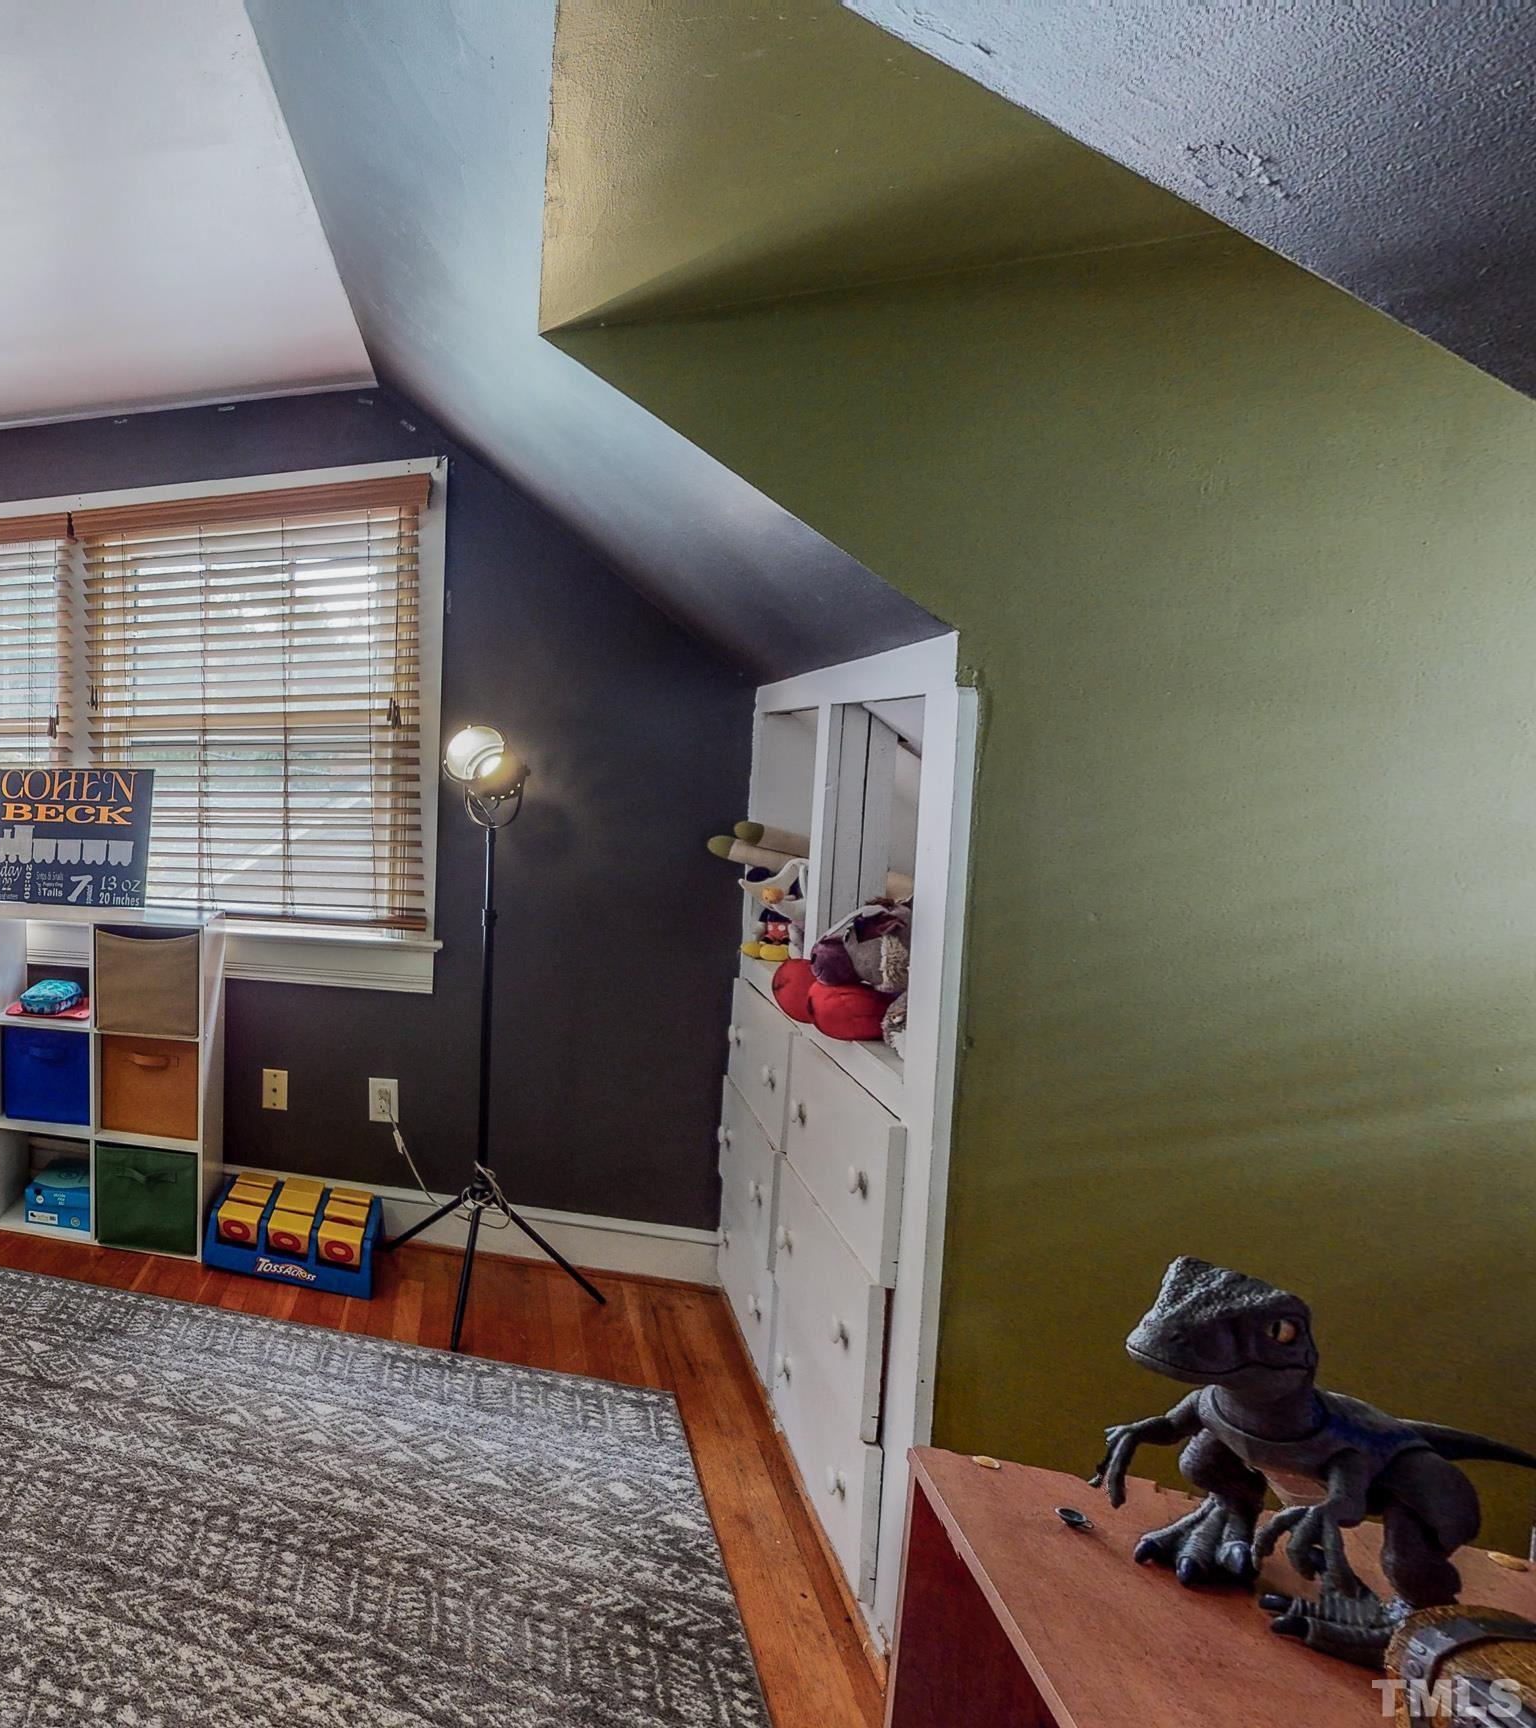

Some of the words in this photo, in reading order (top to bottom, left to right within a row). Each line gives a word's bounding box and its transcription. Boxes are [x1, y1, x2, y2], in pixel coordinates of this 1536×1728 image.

[1, 770, 138, 803] COHEN
[1, 802, 134, 825] BECK
[67, 874, 93, 903] 7
[101, 875, 117, 891] 13
[99, 892, 111, 905] 20
[112, 893, 140, 907] inches
